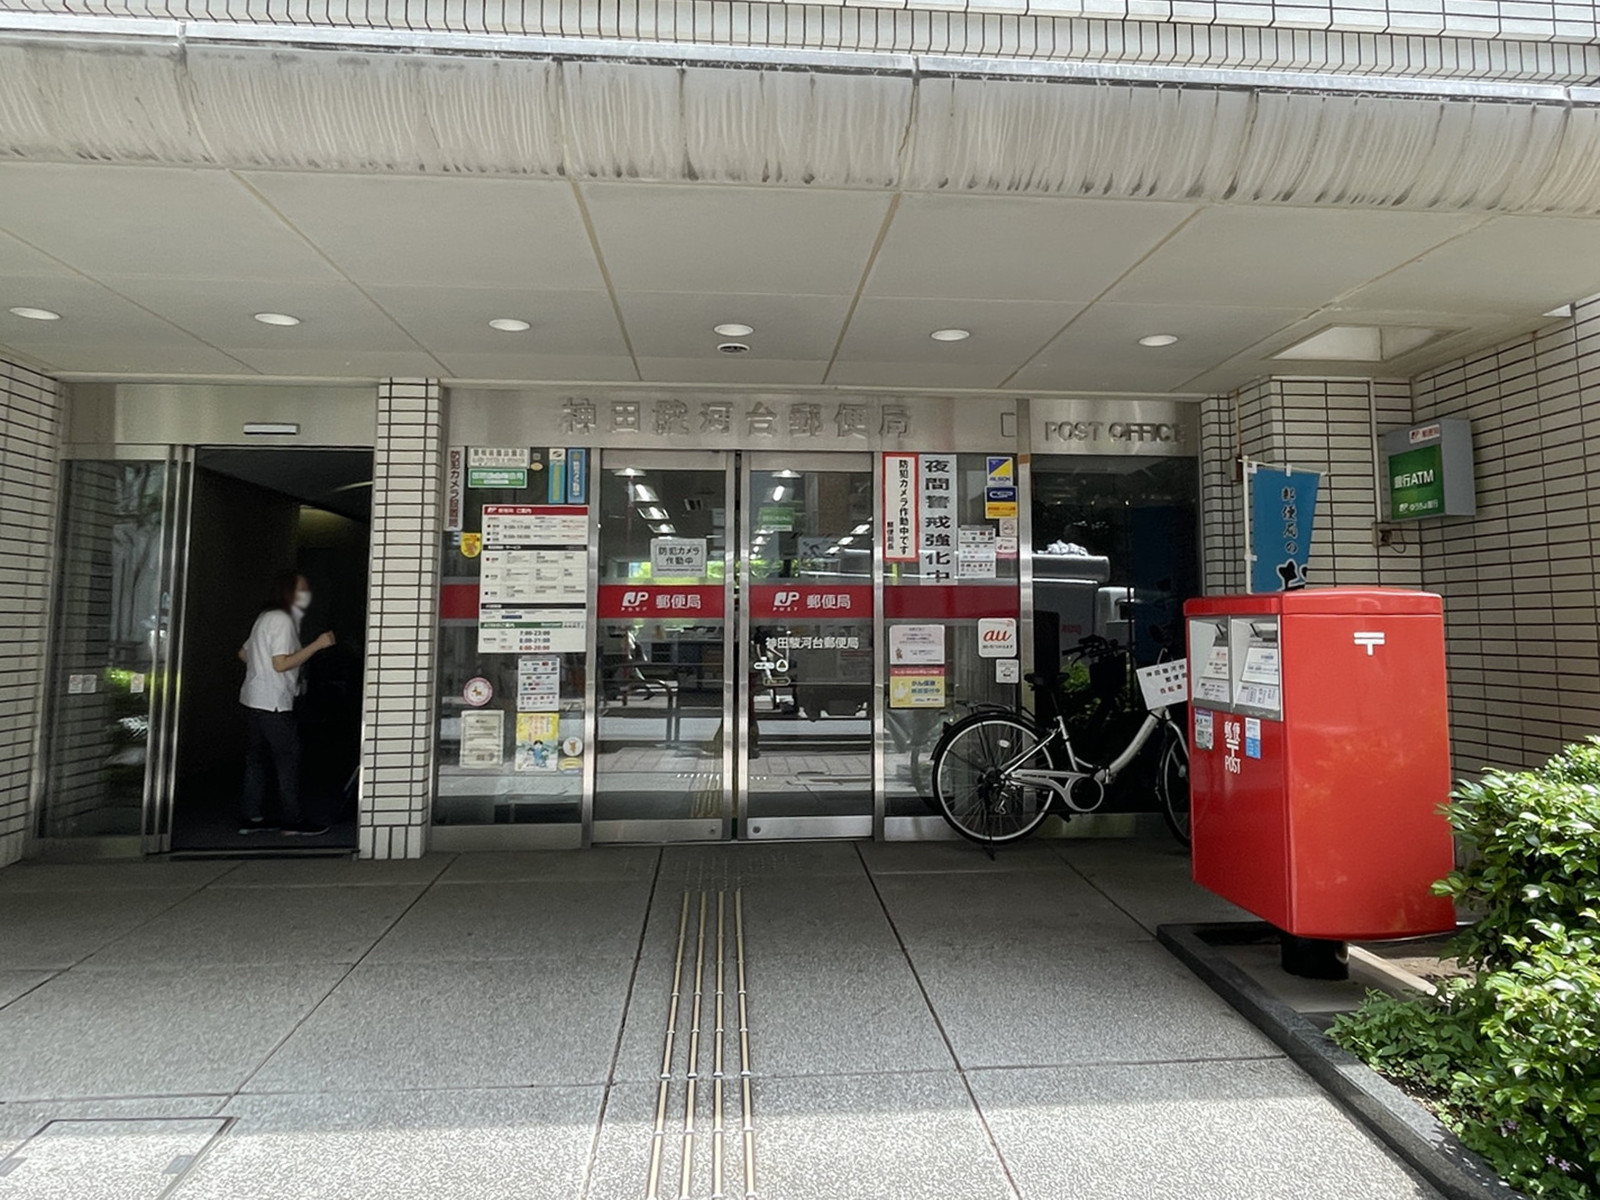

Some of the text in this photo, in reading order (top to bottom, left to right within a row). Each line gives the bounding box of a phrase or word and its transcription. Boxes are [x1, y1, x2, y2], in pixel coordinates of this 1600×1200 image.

[561, 398, 912, 437] 神田駿河台郵便局
[1044, 421, 1187, 443] POST OFFICE
[925, 460, 951, 583] 夜間警戒強化中
[658, 546, 700, 555] 防犯カメラ
[656, 594, 702, 609] 郵便局
[806, 594, 851, 609] 郵便局
[765, 636, 860, 650] 神田駿河台郵便局
[982, 630, 1012, 642] au
[1224, 753, 1241, 774] POST
